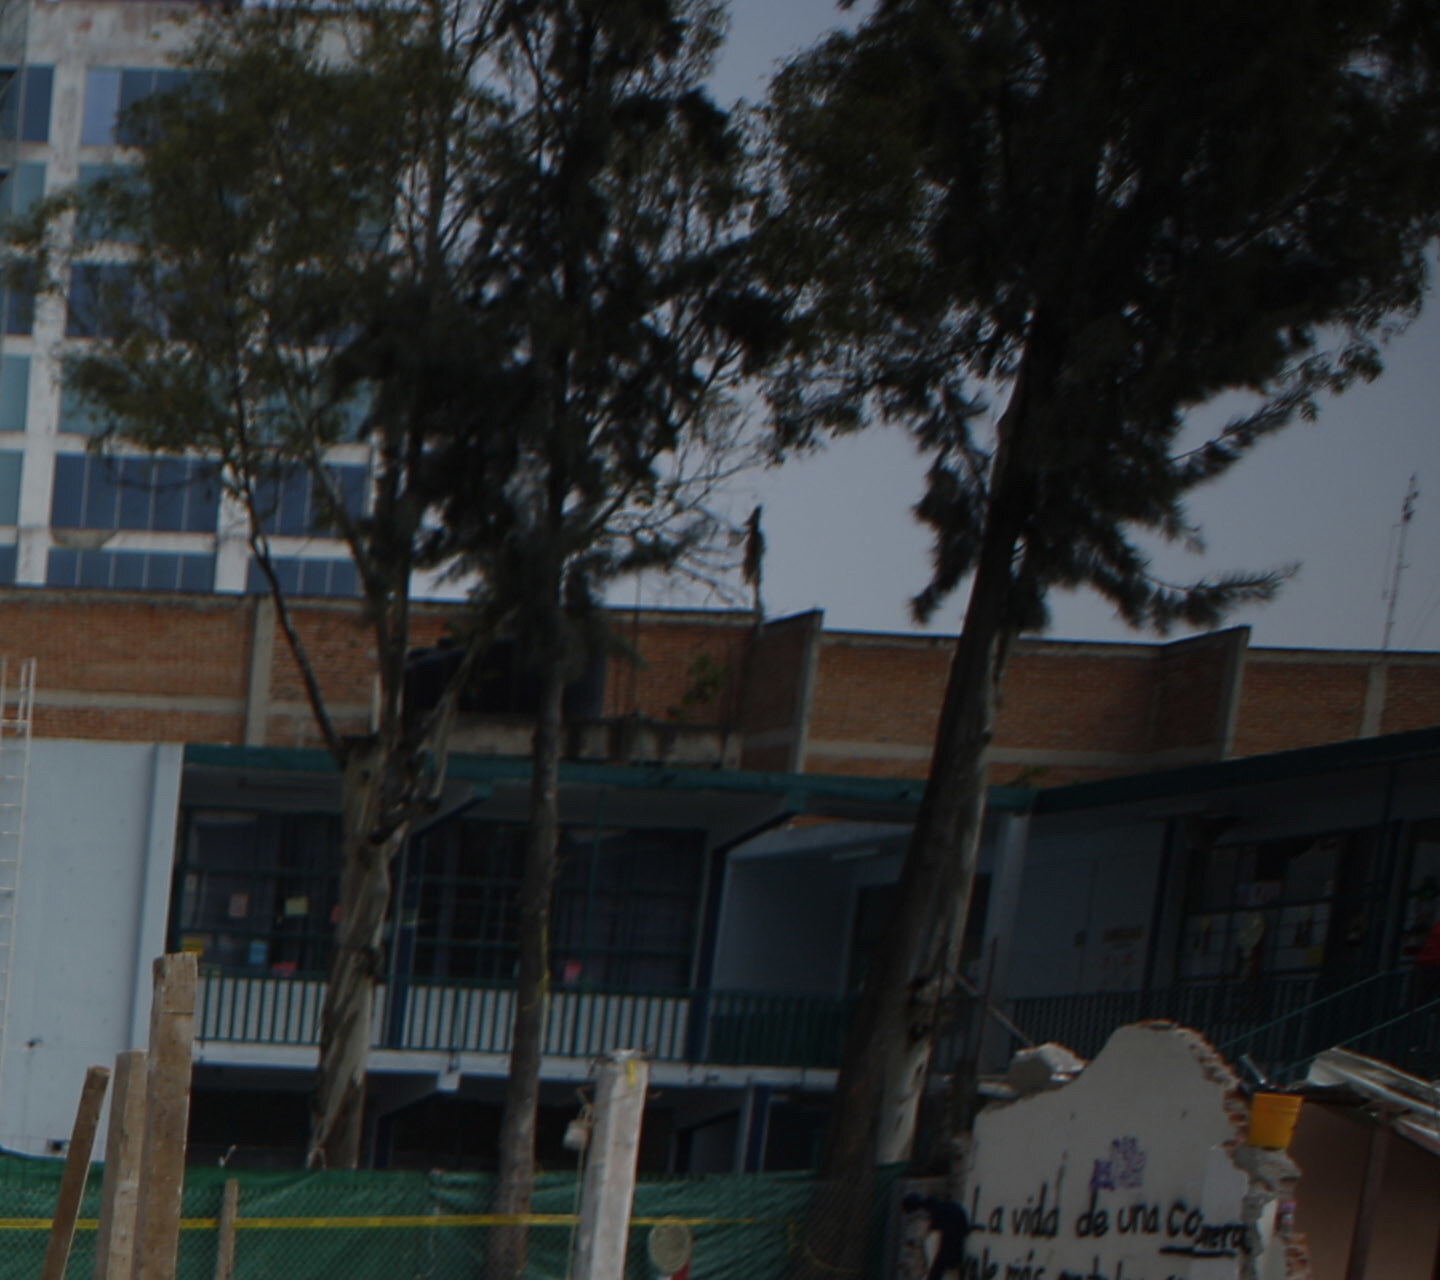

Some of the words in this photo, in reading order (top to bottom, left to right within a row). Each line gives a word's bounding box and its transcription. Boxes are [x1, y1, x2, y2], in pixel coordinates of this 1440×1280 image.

[1012, 1181, 1060, 1238] vida
[1075, 1188, 1111, 1239] de
[1116, 1202, 1161, 1238] una
